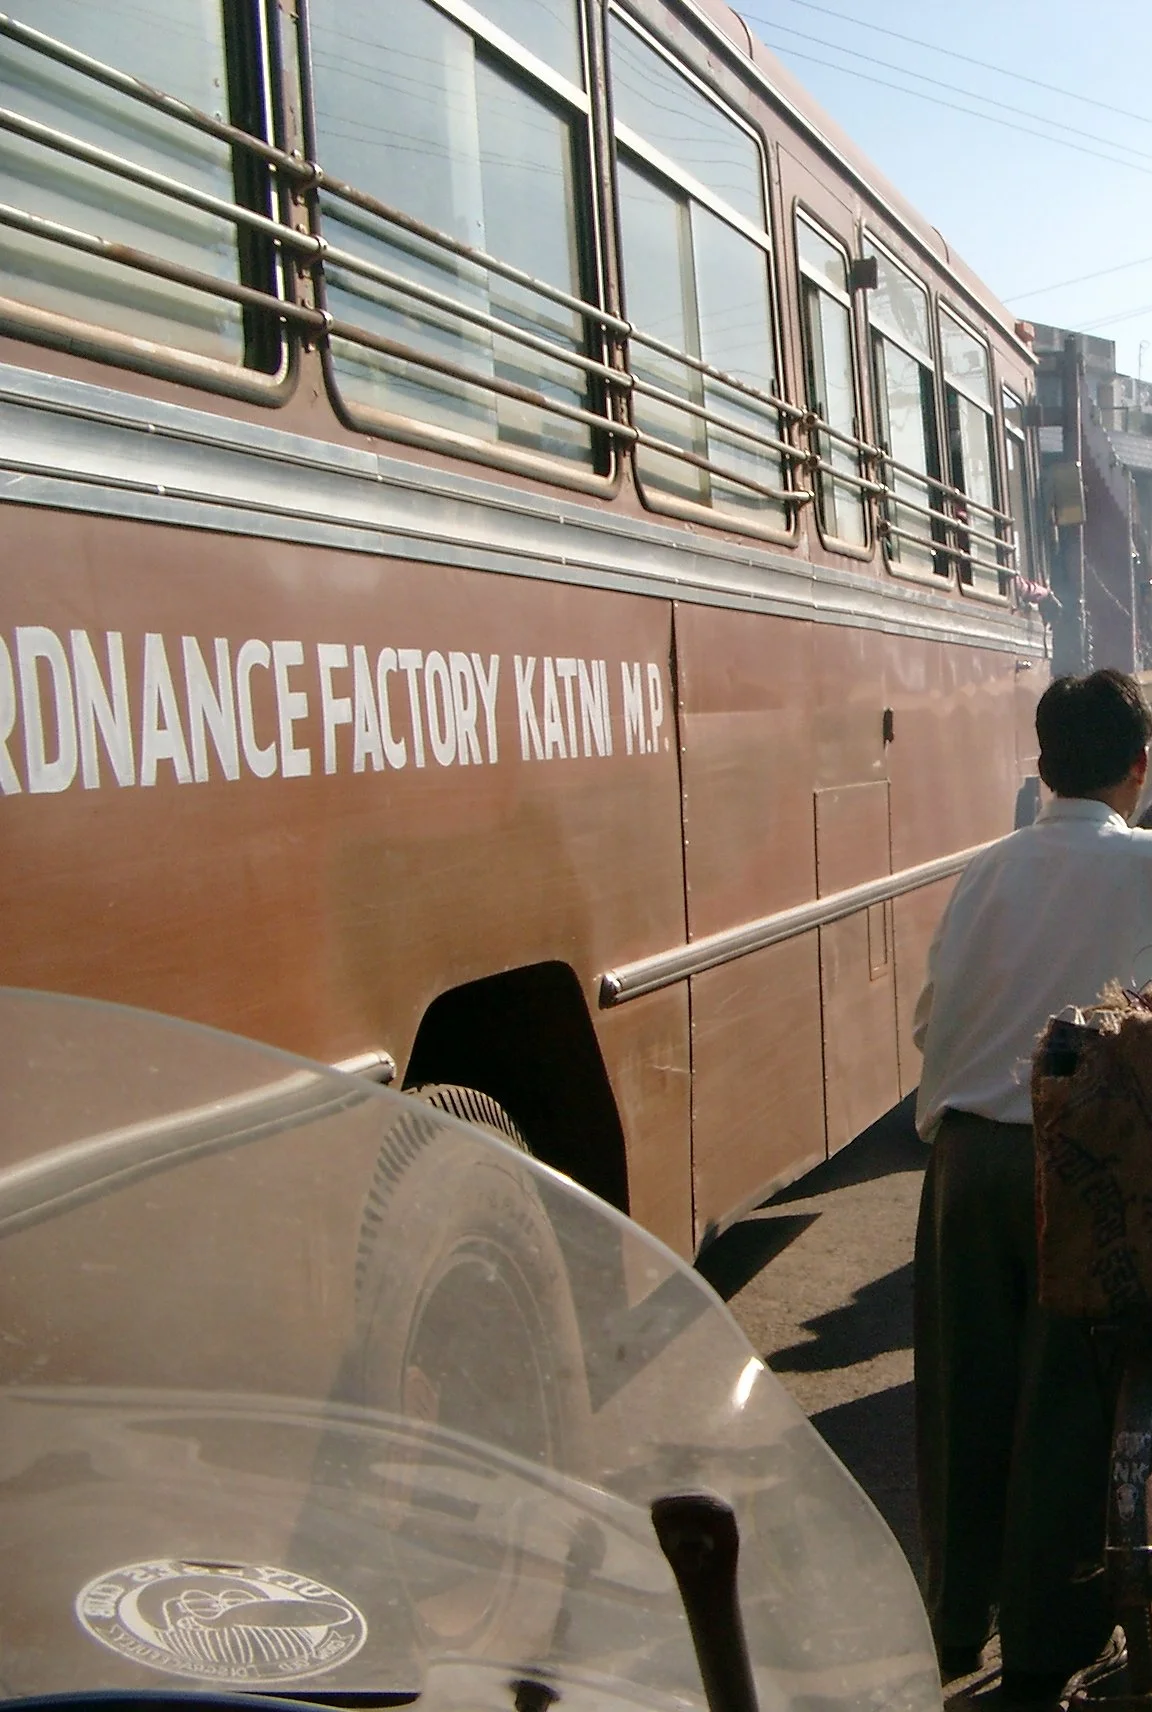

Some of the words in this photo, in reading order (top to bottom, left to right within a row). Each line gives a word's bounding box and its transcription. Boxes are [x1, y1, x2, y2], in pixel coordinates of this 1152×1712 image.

[316, 643, 500, 775] FACTORY
[513, 653, 613, 761] KATNI
[620, 661, 670, 755] M.P.
